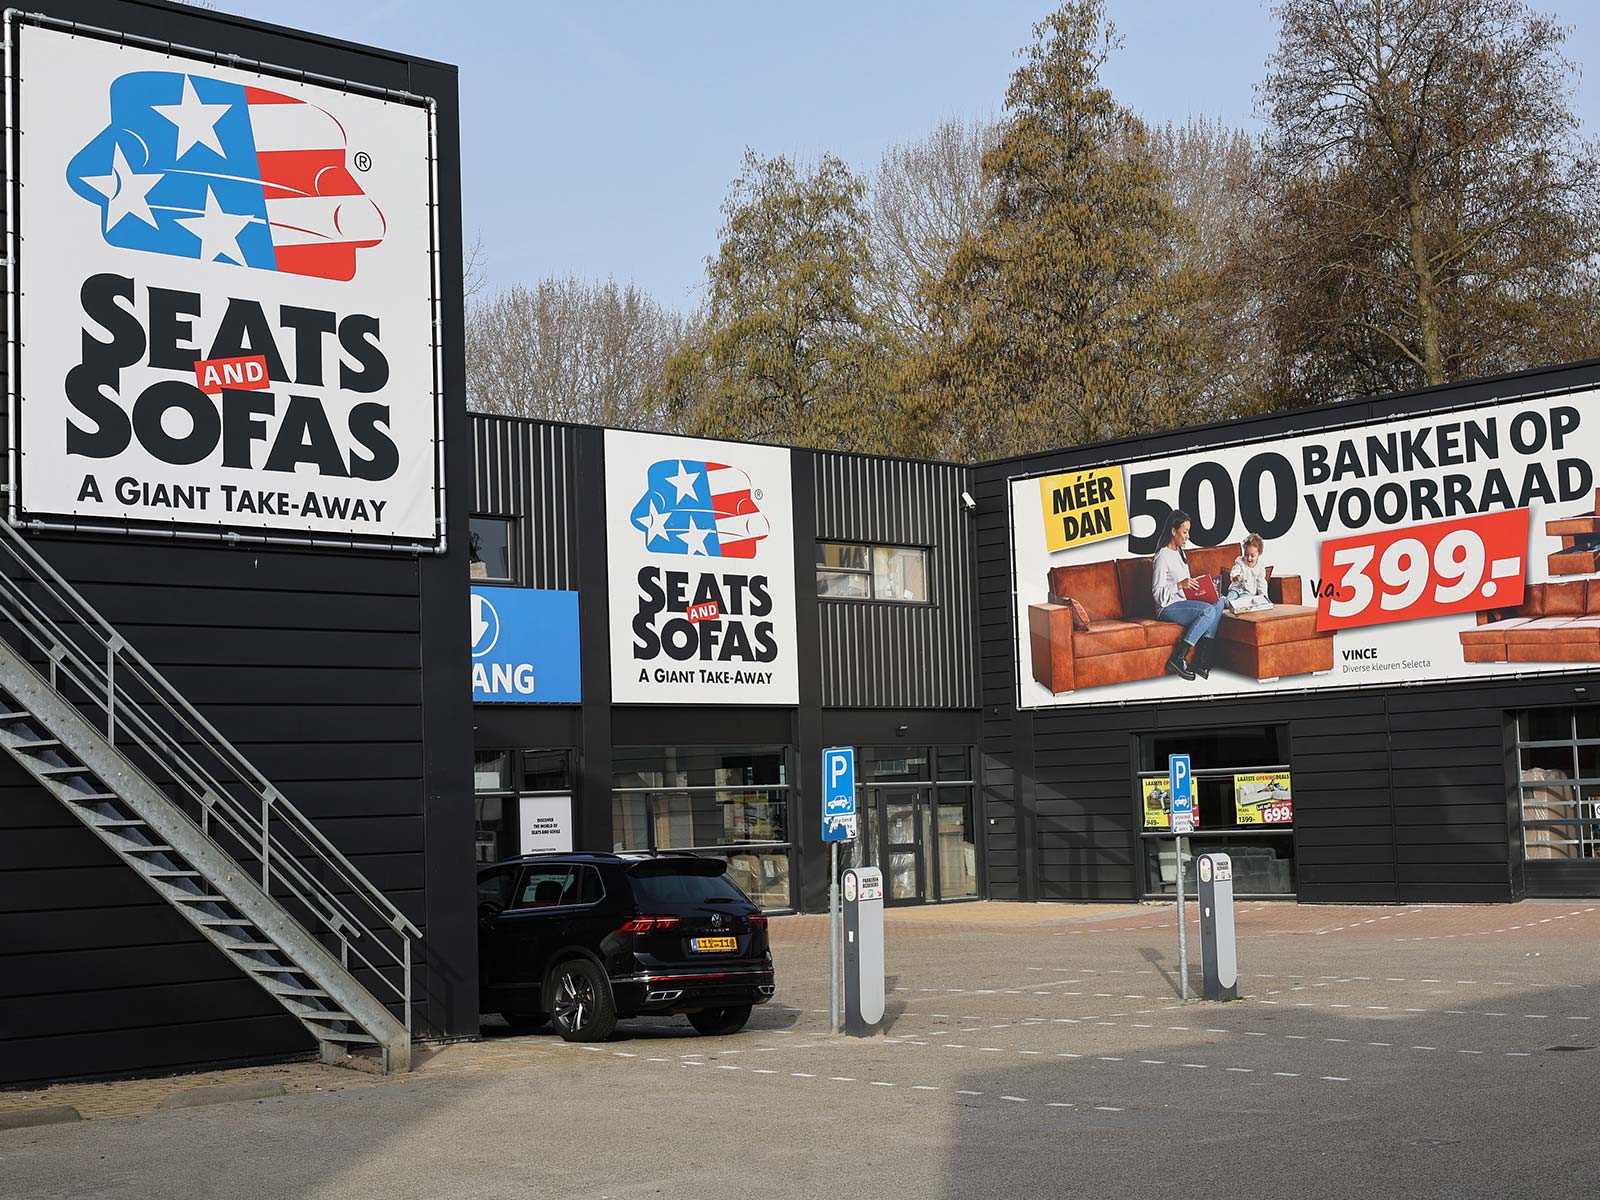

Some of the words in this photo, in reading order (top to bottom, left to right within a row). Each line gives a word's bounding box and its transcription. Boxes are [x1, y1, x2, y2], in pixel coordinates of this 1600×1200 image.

[80, 273, 389, 394] SEATS
[203, 359, 265, 387] AND
[65, 363, 400, 481] SOFAS
[1302, 416, 1499, 486] BANKEN
[1509, 406, 1581, 455] OP
[77, 474, 103, 502] A
[115, 476, 210, 510] GIANT
[220, 485, 387, 522] TAKE-AWAY
[1052, 472, 1116, 515] MÉÉR
[1128, 452, 1298, 554] 500
[1303, 457, 1593, 533] VOORRAAD
[1063, 507, 1113, 542] DAN
[637, 566, 773, 617] SEATS
[1328, 529, 1521, 618] 399.-
[690, 604, 717, 620] AND
[632, 611, 778, 663] SOFAS
[1342, 648, 1378, 661] VINCE
[638, 668, 649, 683] A
[654, 667, 695, 684] GIANT
[699, 669, 773, 685] TAKE-AWAY
[1342, 663, 1371, 674] Diverse
[1372, 661, 1400, 672] kleuren
[1402, 659, 1431, 669] Selecta
[832, 756, 848, 788] P
[1175, 761, 1186, 789] P
